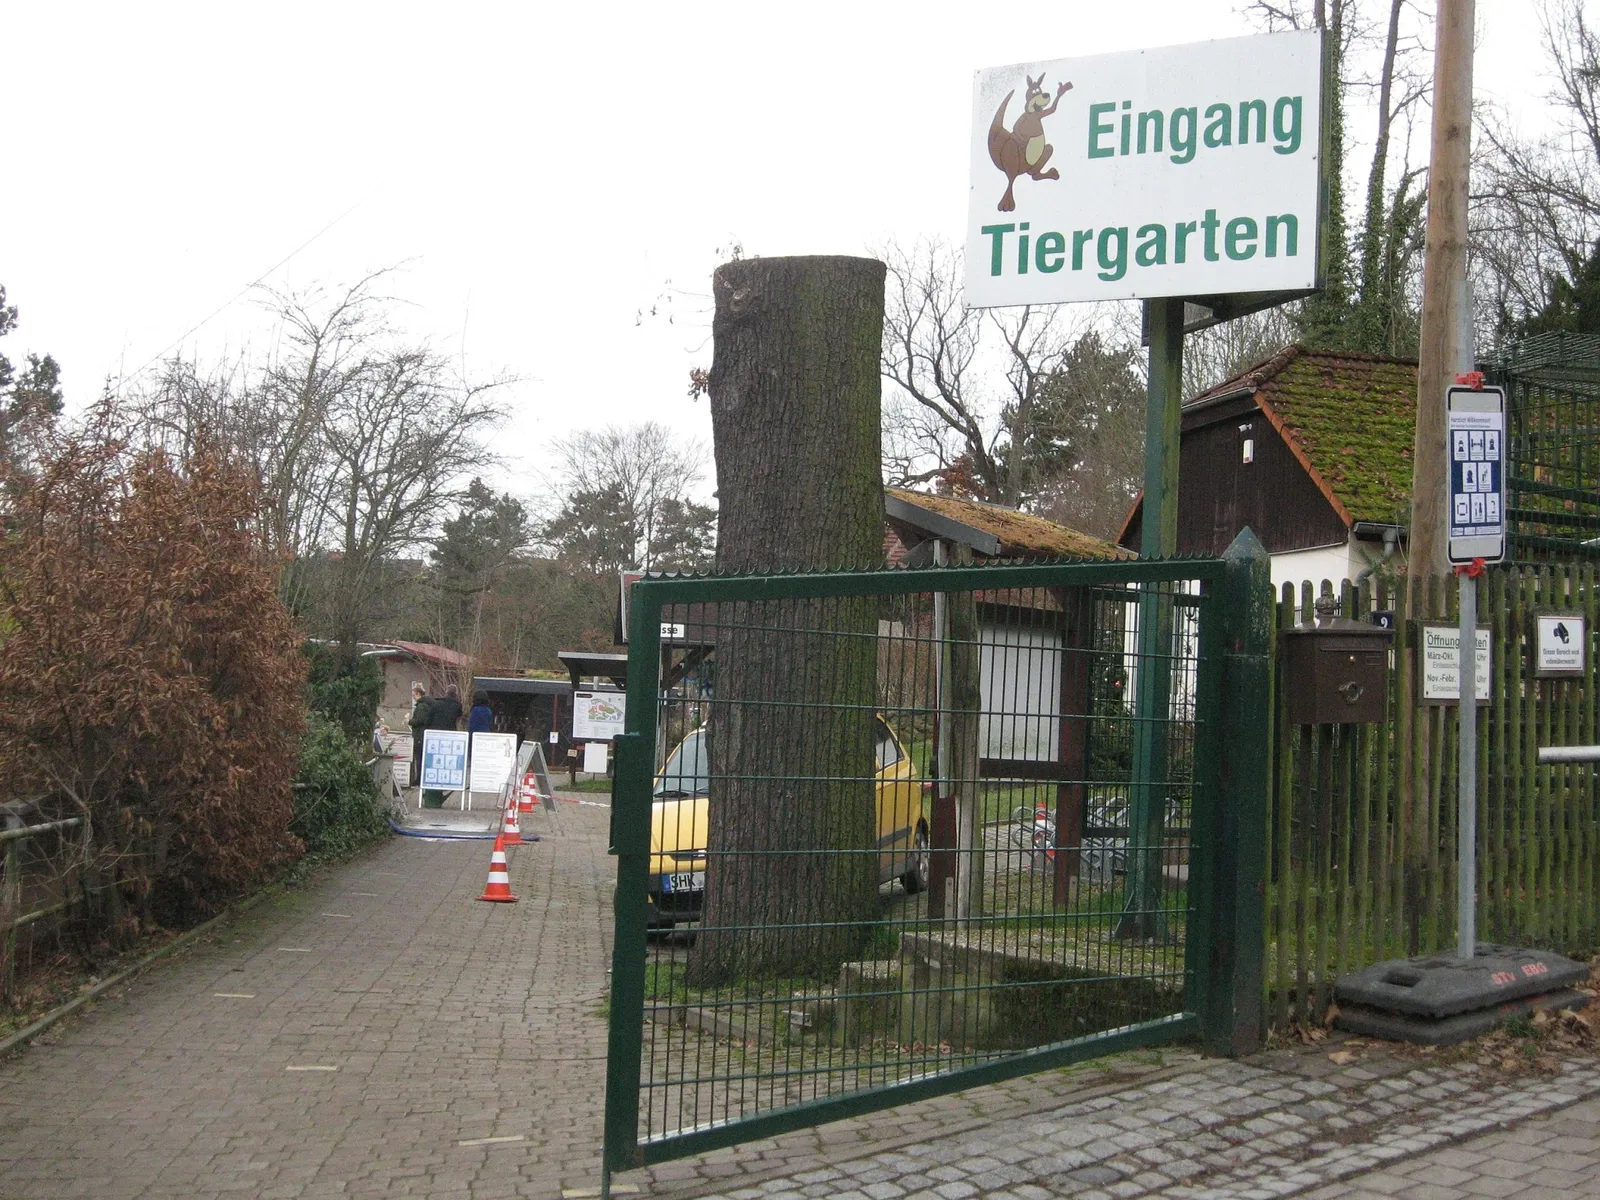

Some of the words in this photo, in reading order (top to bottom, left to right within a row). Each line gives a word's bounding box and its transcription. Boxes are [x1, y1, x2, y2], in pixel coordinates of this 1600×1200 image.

[1088, 95, 1303, 165] Eingang
[981, 208, 1299, 281] Tiergarten
[1476, 675, 1487, 683] Uhr
